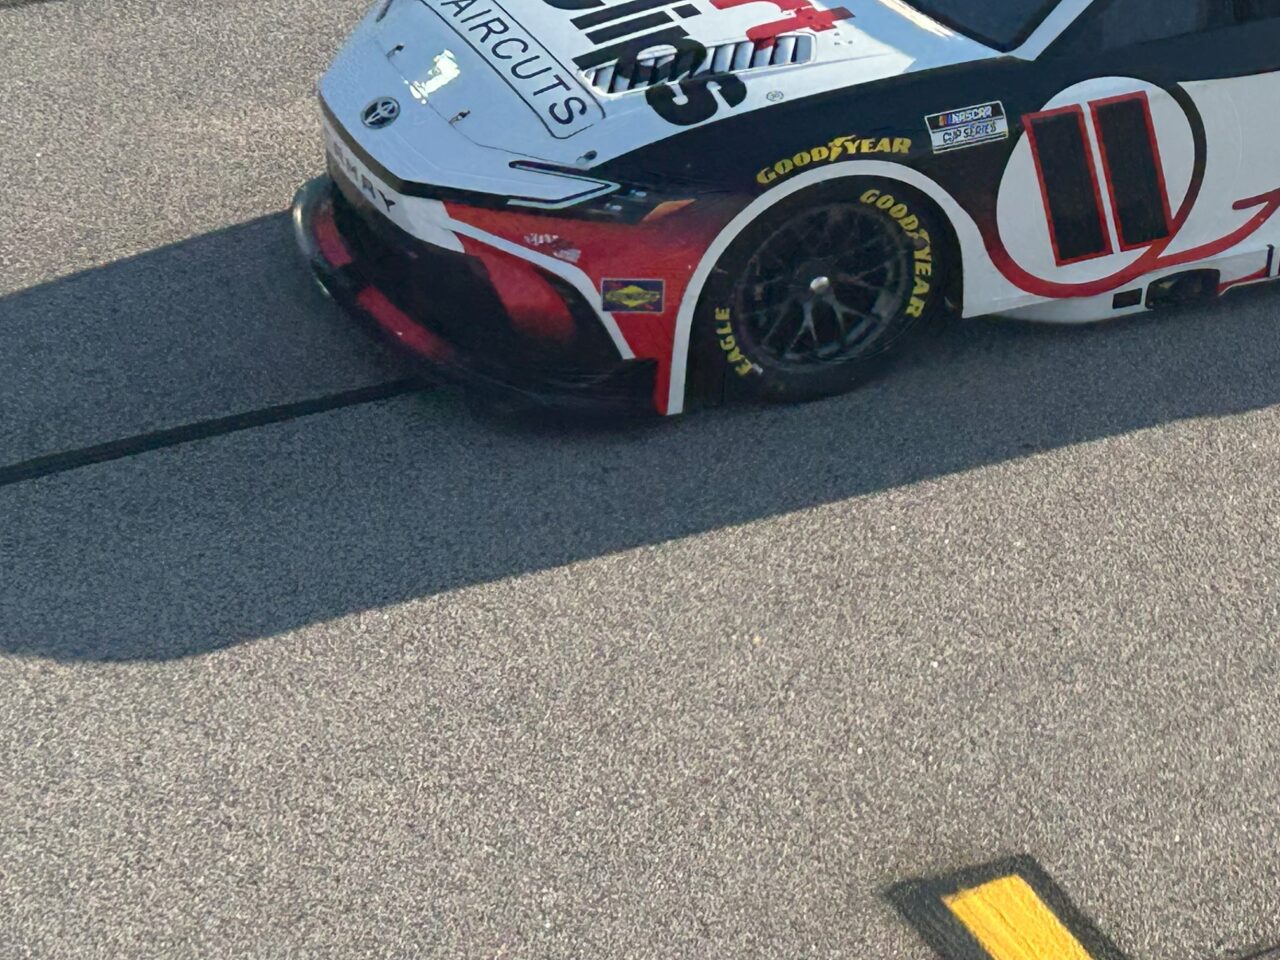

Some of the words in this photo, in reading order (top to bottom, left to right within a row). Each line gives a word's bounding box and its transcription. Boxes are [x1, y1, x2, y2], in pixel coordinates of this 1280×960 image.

[756, 134, 912, 185] GOODYEAR
[1021, 90, 1175, 267] 11
[859, 189, 932, 318] GOODYEAR
[715, 306, 753, 376] EAGLE
